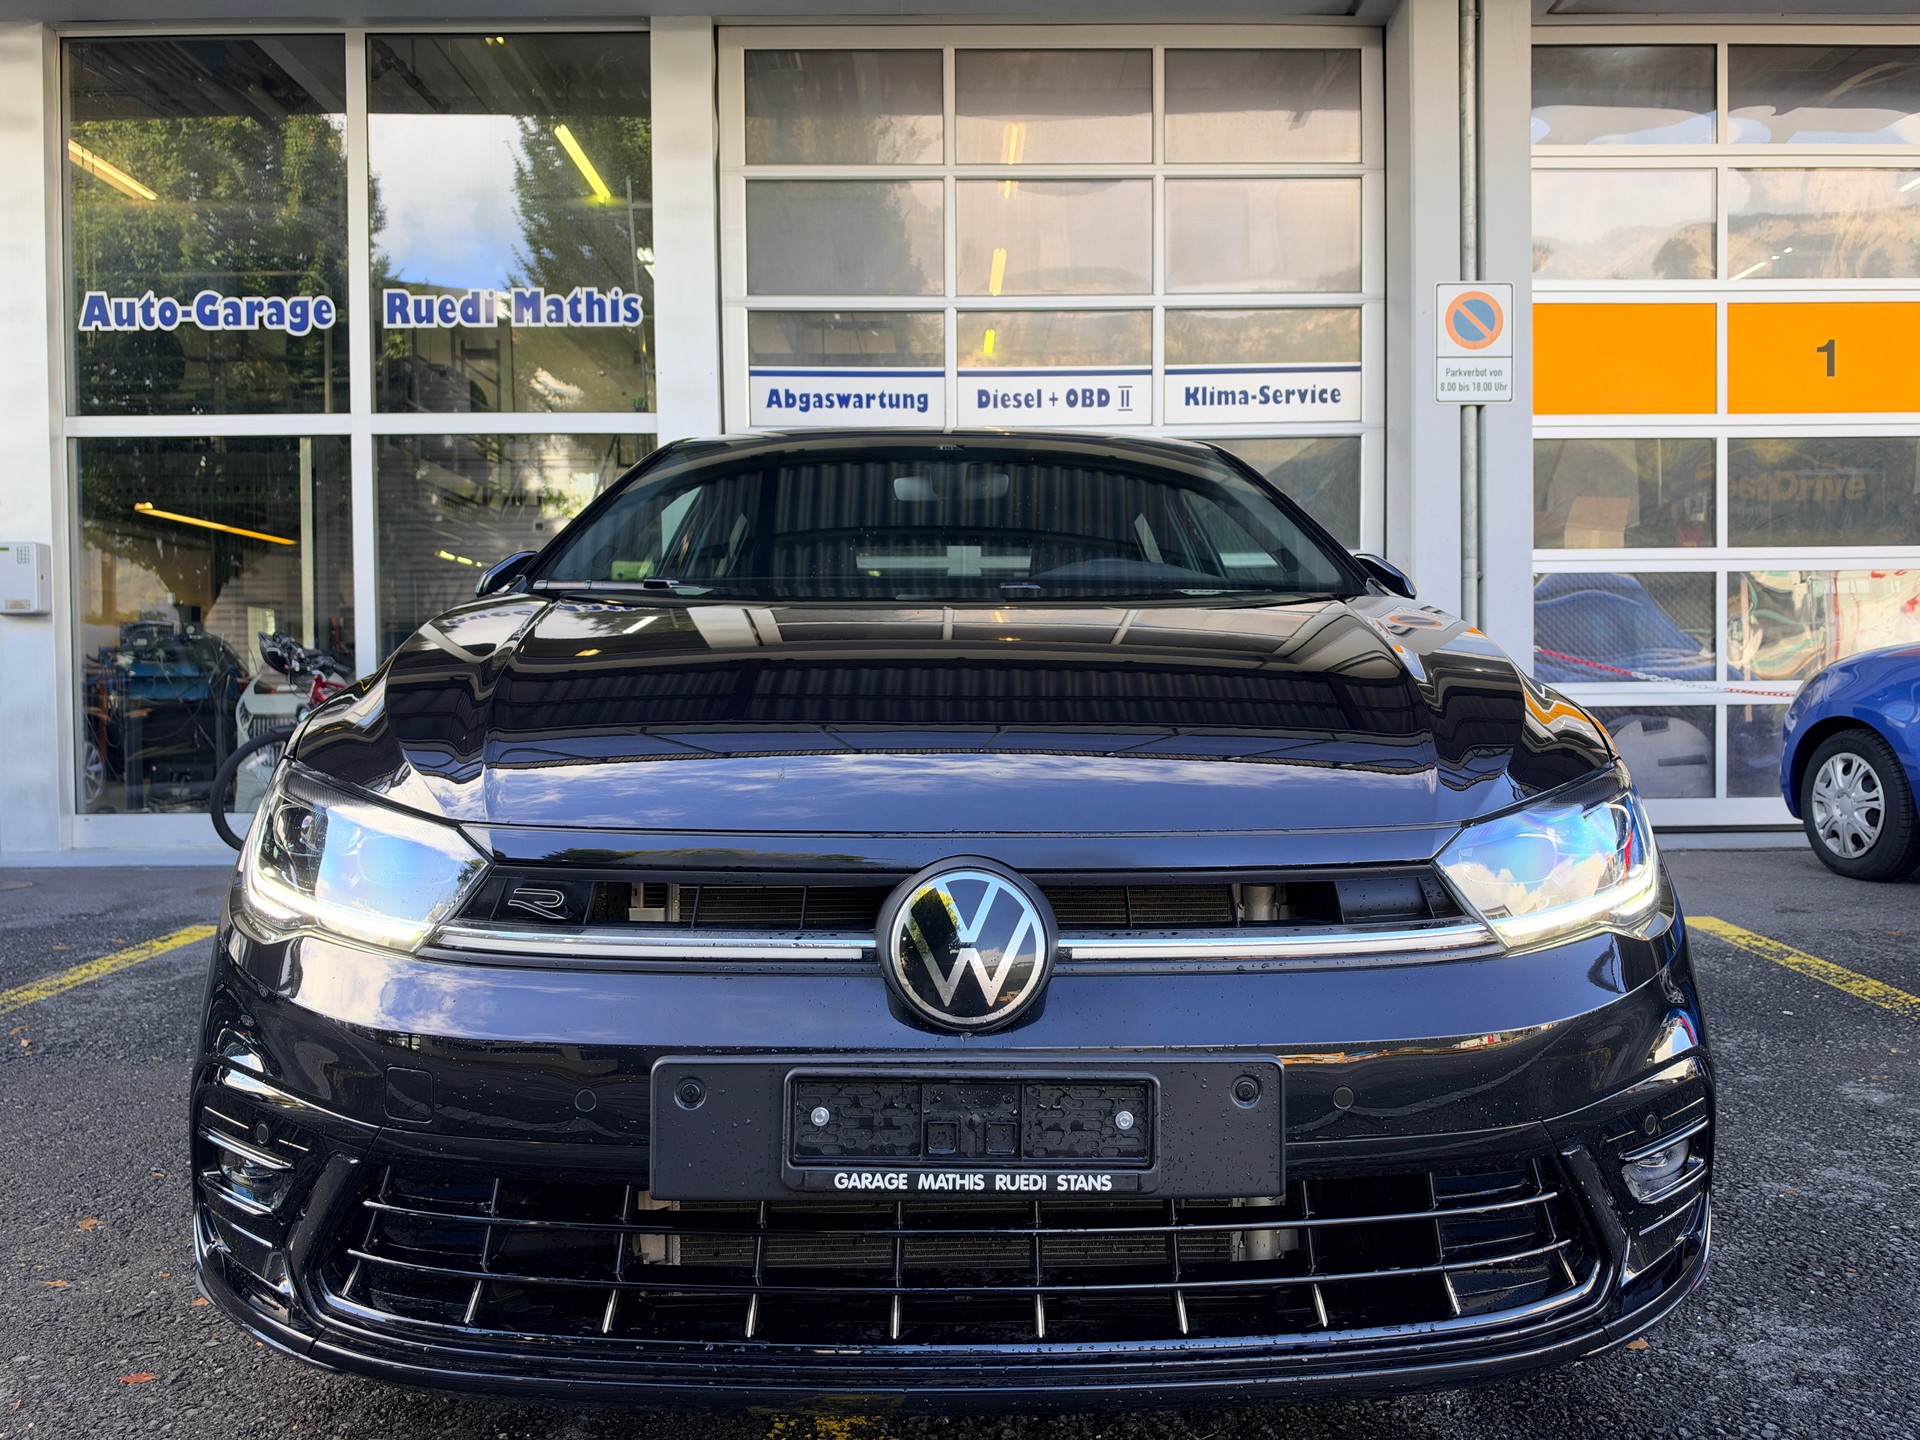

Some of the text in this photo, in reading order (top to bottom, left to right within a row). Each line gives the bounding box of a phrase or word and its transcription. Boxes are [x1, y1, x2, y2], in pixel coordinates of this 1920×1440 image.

[79, 289, 335, 335] Auto-Garage
[383, 287, 643, 328] Ruedi Mathis
[1816, 338, 1836, 377] 1
[1445, 367, 1503, 377] Parkverbot von
[1184, 384, 1342, 406] Klima-Service
[1440, 382, 1508, 392] 8.00 bis 18.00 Uhr
[766, 388, 929, 413] Abgaswartung
[977, 389, 1042, 409] Diesel
[1065, 388, 1111, 408] OBD
[834, 1172, 1112, 1192] GARAGE MATHIS RUEDI STANS
